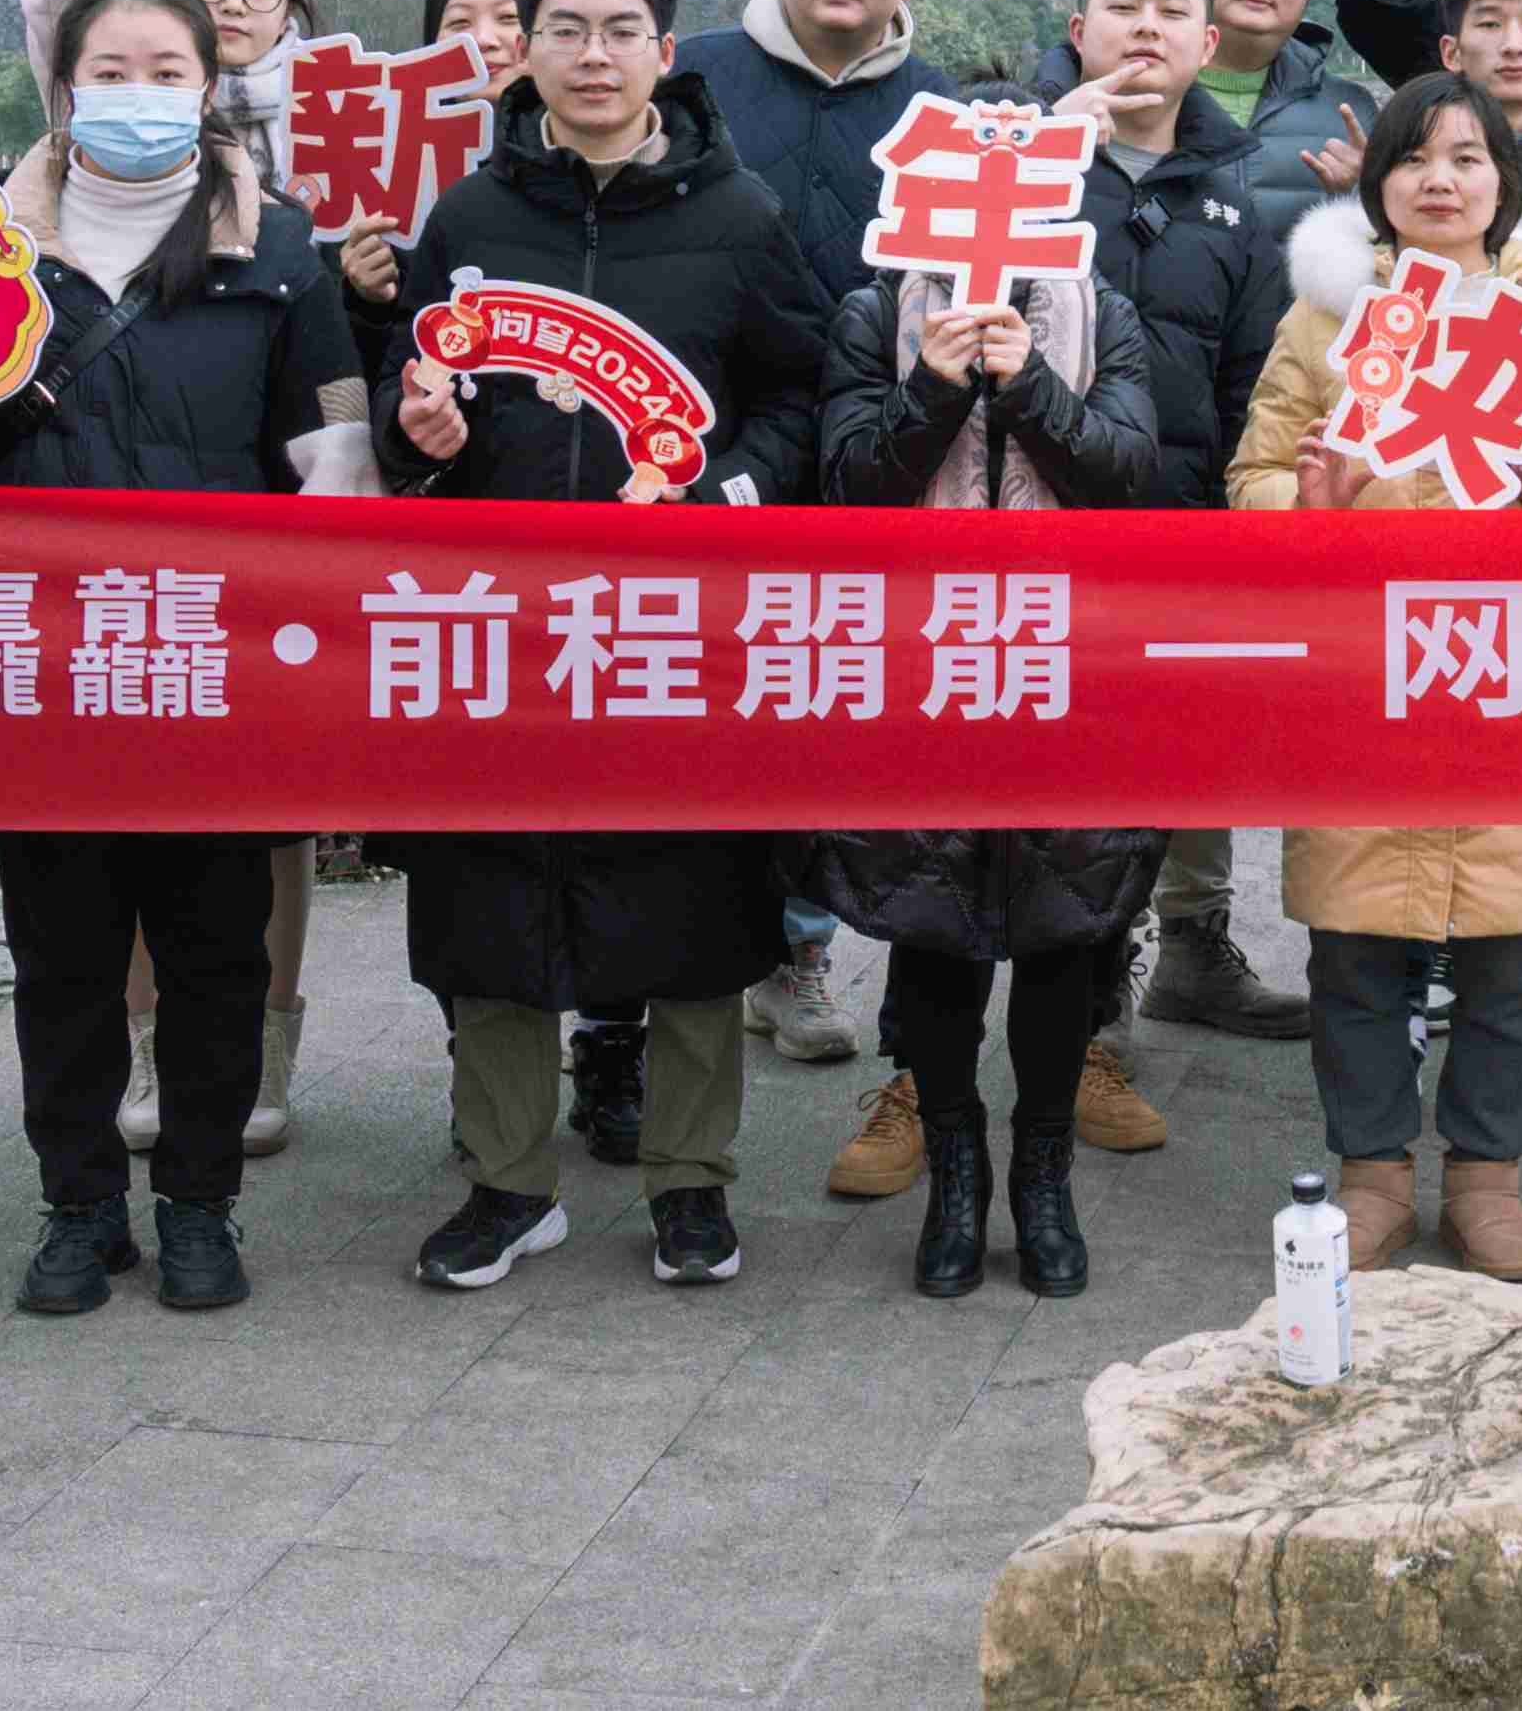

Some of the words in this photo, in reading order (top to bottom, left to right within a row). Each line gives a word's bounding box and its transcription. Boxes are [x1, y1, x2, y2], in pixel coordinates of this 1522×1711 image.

[289, 43, 482, 236] 新
[876, 104, 1085, 305] 年
[442, 331, 468, 355] 好
[653, 438, 677, 460] 运
